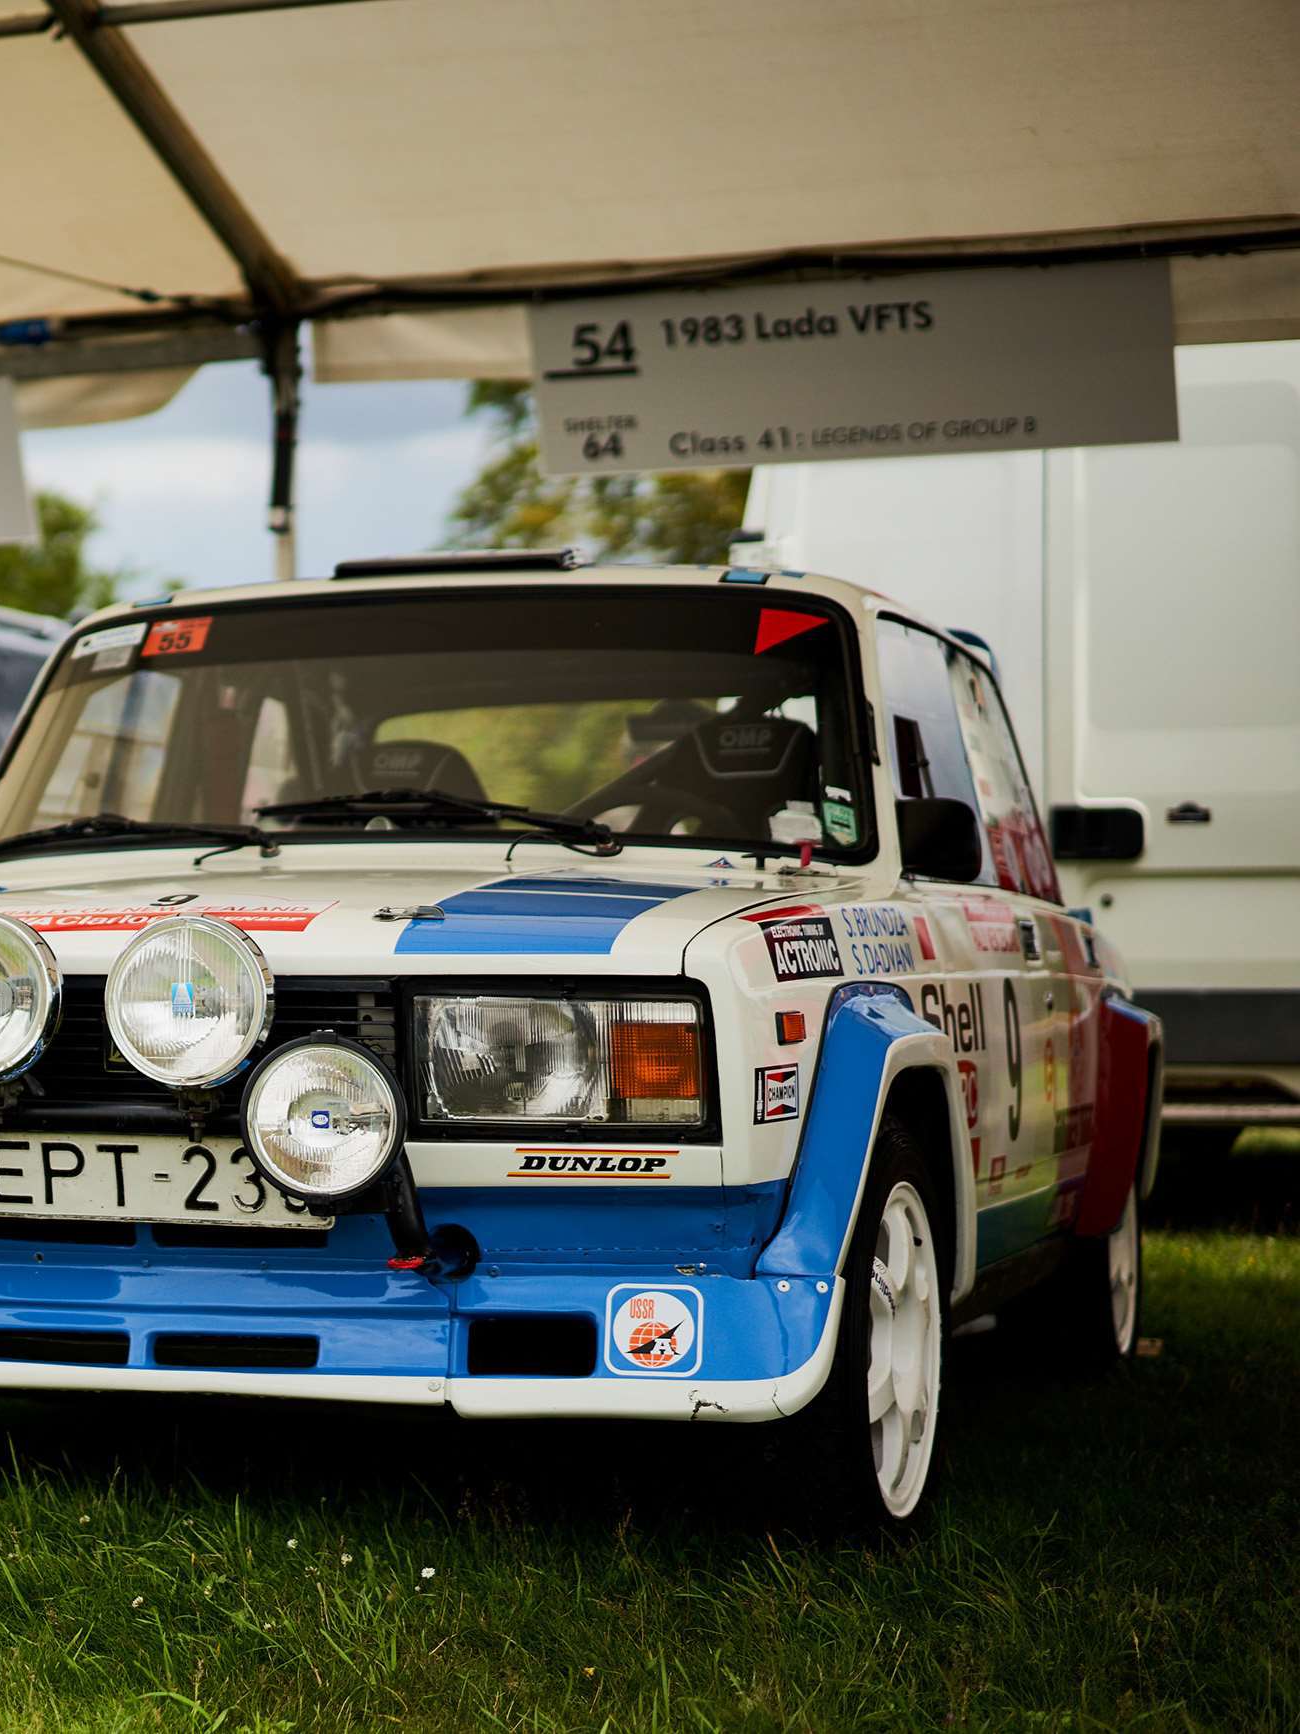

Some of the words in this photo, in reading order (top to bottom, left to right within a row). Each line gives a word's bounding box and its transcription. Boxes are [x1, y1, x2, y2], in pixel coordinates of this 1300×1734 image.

[661, 313, 746, 346] 1983
[755, 306, 839, 340] Lada
[848, 301, 934, 333] VFTS
[573, 319, 636, 366] 54
[563, 414, 638, 434] SHELTER
[668, 430, 746, 459] Class
[811, 422, 902, 447] LEGENDS
[907, 420, 938, 441] OF
[942, 416, 1018, 439] GROUP
[1024, 415, 1038, 433] B
[581, 431, 624, 462] 64
[158, 631, 192, 652] 55
[150, 894, 200, 907] 9
[774, 938, 839, 975] ACTRONIC
[921, 982, 987, 1054] Shell
[1003, 976, 1023, 1142] 9
[768, 1084, 796, 1102] CHAMPION
[519, 1155, 667, 1172] DUNLOP
[629, 1298, 655, 1319] USSR
